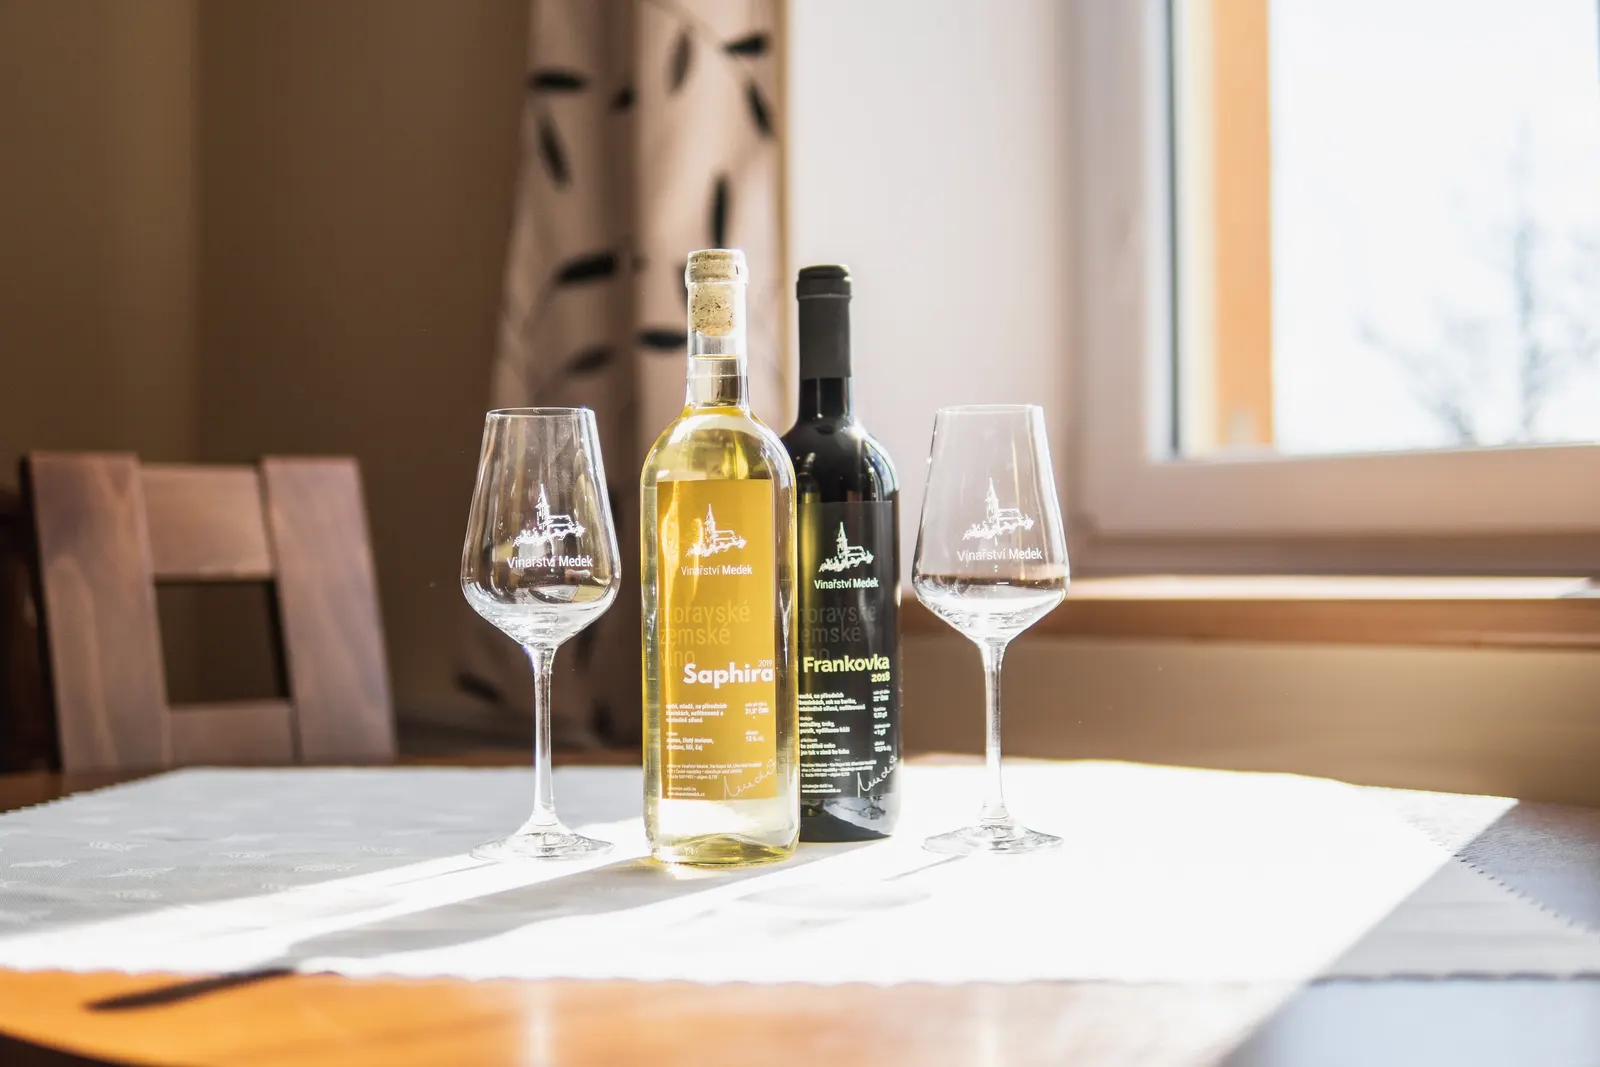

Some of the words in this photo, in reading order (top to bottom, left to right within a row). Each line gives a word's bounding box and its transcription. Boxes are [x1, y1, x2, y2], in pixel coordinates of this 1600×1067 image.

[956, 548, 1006, 562] Vinařství
[1008, 546, 1043, 560] Medek
[506, 555, 556, 569] Vinařství
[558, 554, 593, 567] Medek
[681, 564, 720, 576] Vinařství
[721, 564, 753, 576] Medek
[813, 578, 852, 590] Vinařství
[852, 577, 879, 589] Medek
[758, 659, 773, 668] 2019
[802, 653, 891, 674] Frankovka
[682, 660, 774, 690] Saphira
[870, 671, 891, 683] 2018
